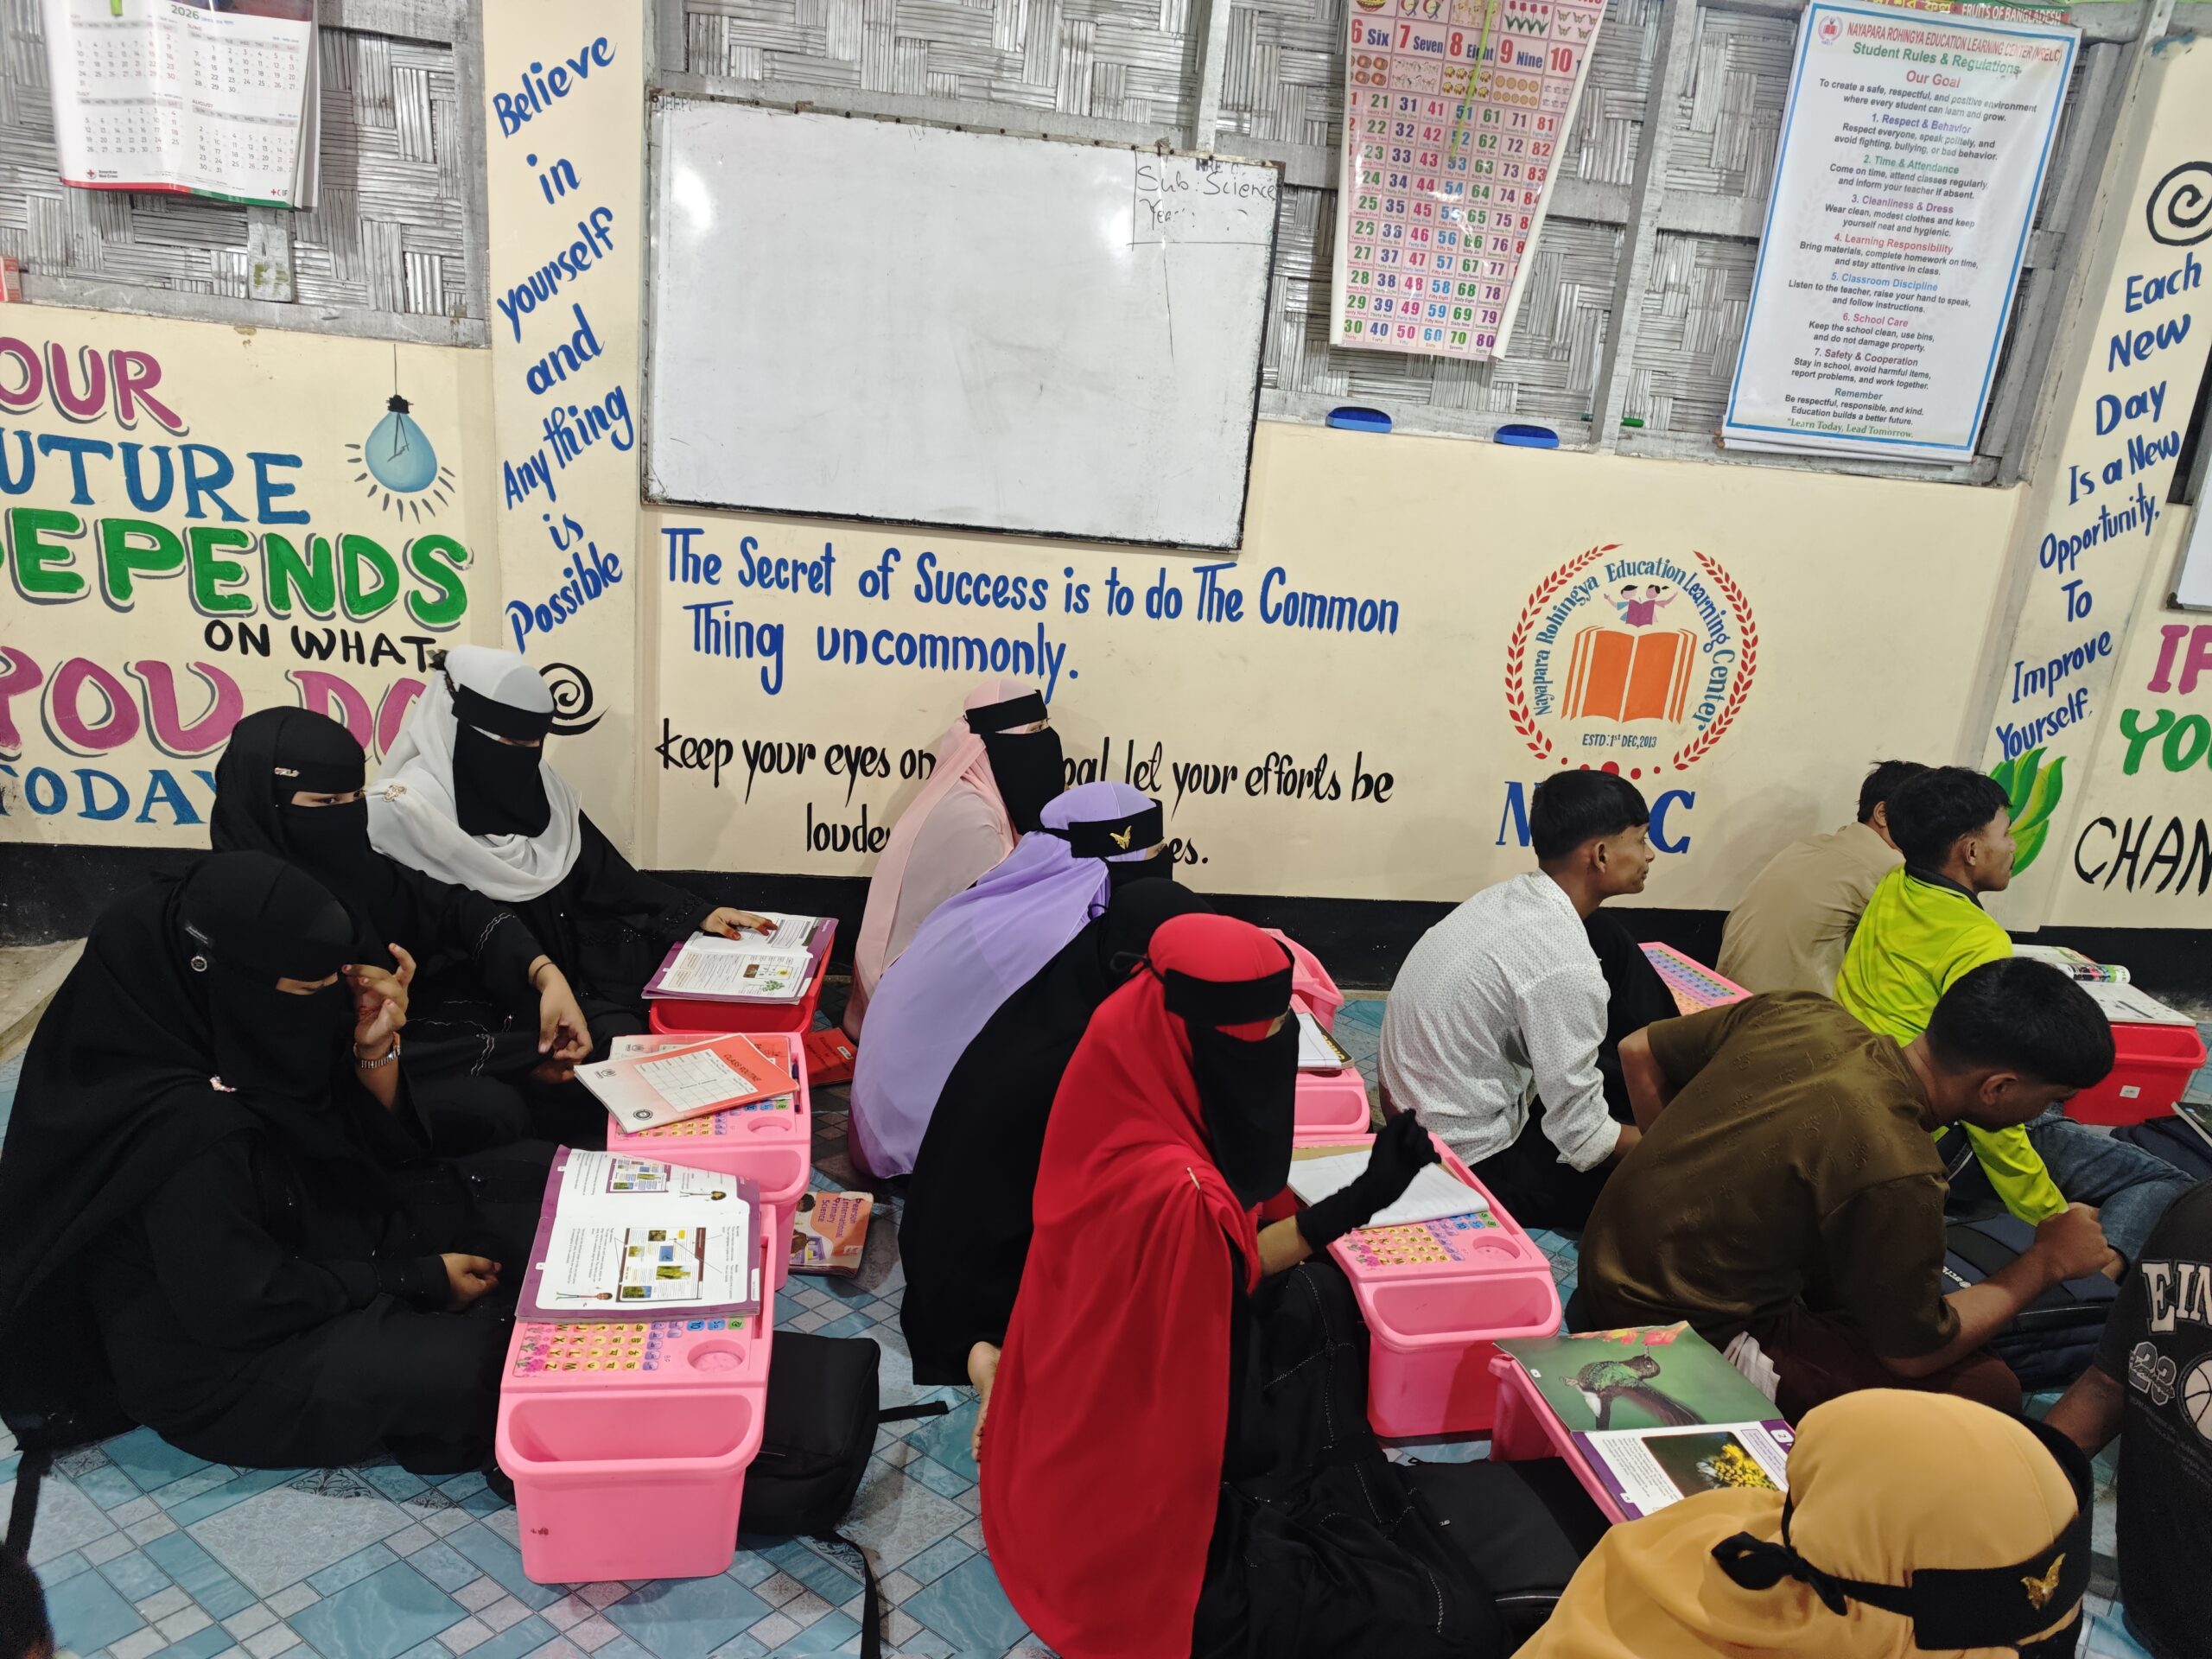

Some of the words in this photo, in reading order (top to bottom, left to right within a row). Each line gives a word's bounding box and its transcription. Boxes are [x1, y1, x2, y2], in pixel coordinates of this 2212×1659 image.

[170, 4, 200, 20] 2026
[1961, 3, 1991, 18] FRUITS
[1992, 5, 2004, 19] OF
[2005, 7, 2062, 26] BANGLADESH
[1351, 18, 1363, 43] 6
[1367, 28, 1389, 48] Six
[1398, 23, 1411, 49] 7
[1413, 35, 1444, 55] Seven
[1449, 31, 1463, 57] 8
[1466, 43, 1494, 61] Eiht
[1847, 22, 1886, 41] NAYAPARA
[1886, 27, 1925, 45] ROHINGYA
[1925, 32, 1967, 51] EDUCATION
[1967, 38, 2005, 56] LEARNING
[2005, 42, 2033, 60] CENTER
[1500, 39, 1514, 64] 9
[1516, 51, 1543, 69] Nine
[1550, 47, 1573, 73] 10
[1853, 41, 1901, 60] Student
[1903, 48, 1937, 64] Rules
[1940, 53, 1949, 66] &
[1951, 54, 2022, 74] Regulations
[493, 37, 618, 138] Believe
[1906, 70, 1930, 84] Our
[1932, 73, 1961, 88] Goal
[1872, 113, 1879, 123] 1.
[1881, 113, 1920, 129] Respect
[1921, 118, 1929, 129] &
[1931, 119, 1972, 134] Behavior
[526, 154, 582, 205] in
[1863, 154, 1872, 164] 2.
[1874, 156, 1896, 168] Time
[1898, 158, 1905, 168] &
[1907, 159, 1960, 175] Attendance
[1202, 171, 1277, 200] Science
[1851, 194, 1859, 204] 3.
[1862, 195, 1914, 210] Cleanliness
[1916, 201, 1923, 211] &
[1925, 202, 1955, 214] Dress
[1353, 245, 1371, 261] 27
[1380, 248, 1399, 264] 37
[1408, 251, 1426, 267] 47
[1436, 254, 1453, 270] 57
[1462, 257, 1479, 273] 67
[1489, 261, 1505, 276] 77
[1834, 232, 1842, 242] 4.
[1845, 233, 1885, 248] Learning
[1887, 238, 1955, 255] Responsibility
[497, 207, 613, 344] yourself
[1832, 272, 1840, 282] 5.
[1841, 273, 1891, 287] Classroom
[1893, 278, 1938, 292] Discipline
[2125, 251, 2202, 313] Each
[1344, 318, 1363, 334] 30
[1370, 322, 1389, 337] 40
[1396, 325, 1416, 340] 50
[1423, 327, 1443, 343] 60
[1450, 330, 1467, 346] 70
[1476, 333, 1496, 348] 80
[1842, 312, 1851, 322] 6.
[1853, 313, 1885, 326] School
[1887, 317, 1909, 327] Care
[526, 302, 605, 395] and
[1815, 348, 1822, 358] 7.
[1824, 349, 1853, 361] Safety
[1855, 353, 1862, 361] &
[1865, 353, 1918, 367] Cooperation
[2108, 314, 2191, 372] New
[1785, 394, 1796, 403] Be
[1797, 395, 1839, 408] respectful,
[1840, 401, 1888, 413] responsible,
[1905, 406, 1924, 416] kind.
[1834, 387, 1883, 401] Remember
[2096, 380, 2167, 435] Day
[1791, 405, 1831, 417] Education
[1833, 409, 1857, 420] builds
[1866, 412, 1887, 423] better
[1889, 415, 1913, 425] future.
[1817, 420, 1844, 433] Today,
[1847, 423, 1866, 434] Lead
[1868, 426, 1914, 439] Tomorrow.
[2069, 465, 2095, 506] Is
[2102, 458, 2123, 485] a
[2127, 430, 2180, 475] New
[542, 513, 584, 551] is
[2039, 482, 2160, 575] Opportunity,
[0, 505, 472, 631] EPENDS
[661, 528, 722, 585] The
[738, 536, 836, 598] Secret
[858, 548, 900, 601] of
[914, 551, 1049, 611] Success
[1064, 567, 1090, 614] is
[1105, 567, 1134, 617] to
[1146, 567, 1183, 620] do
[1192, 562, 1244, 624] The
[1260, 566, 1399, 636] Common
[1604, 556, 1688, 584] Education
[505, 542, 623, 655] Possible
[1535, 575, 1600, 645] Rohingya
[1681, 571, 1731, 653] Learning
[2061, 579, 2093, 622] To
[204, 619, 271, 658] ON
[290, 625, 437, 673] WHAT
[683, 600, 785, 696] Thing
[817, 621, 1078, 705] uncommonly.
[1532, 649, 1554, 716] Nayapara
[2012, 631, 2113, 703] Improve
[1691, 649, 1736, 731] Center
[2120, 709, 2212, 776] YO
[655, 717, 734, 788] keep
[742, 739, 816, 804] your
[824, 743, 891, 808] eyes
[899, 748, 938, 780] on
[1125, 739, 1163, 792] let
[1172, 761, 1237, 822] your
[1245, 751, 1341, 801] efforts
[1351, 751, 1394, 804] be
[0, 764, 217, 824] ODA
[807, 802, 891, 854] loude
[817, 1199, 830, 1223] Science
[827, 1198, 841, 1224] Primary
[836, 1198, 849, 1238] International
[849, 1198, 863, 1224] Pearson
